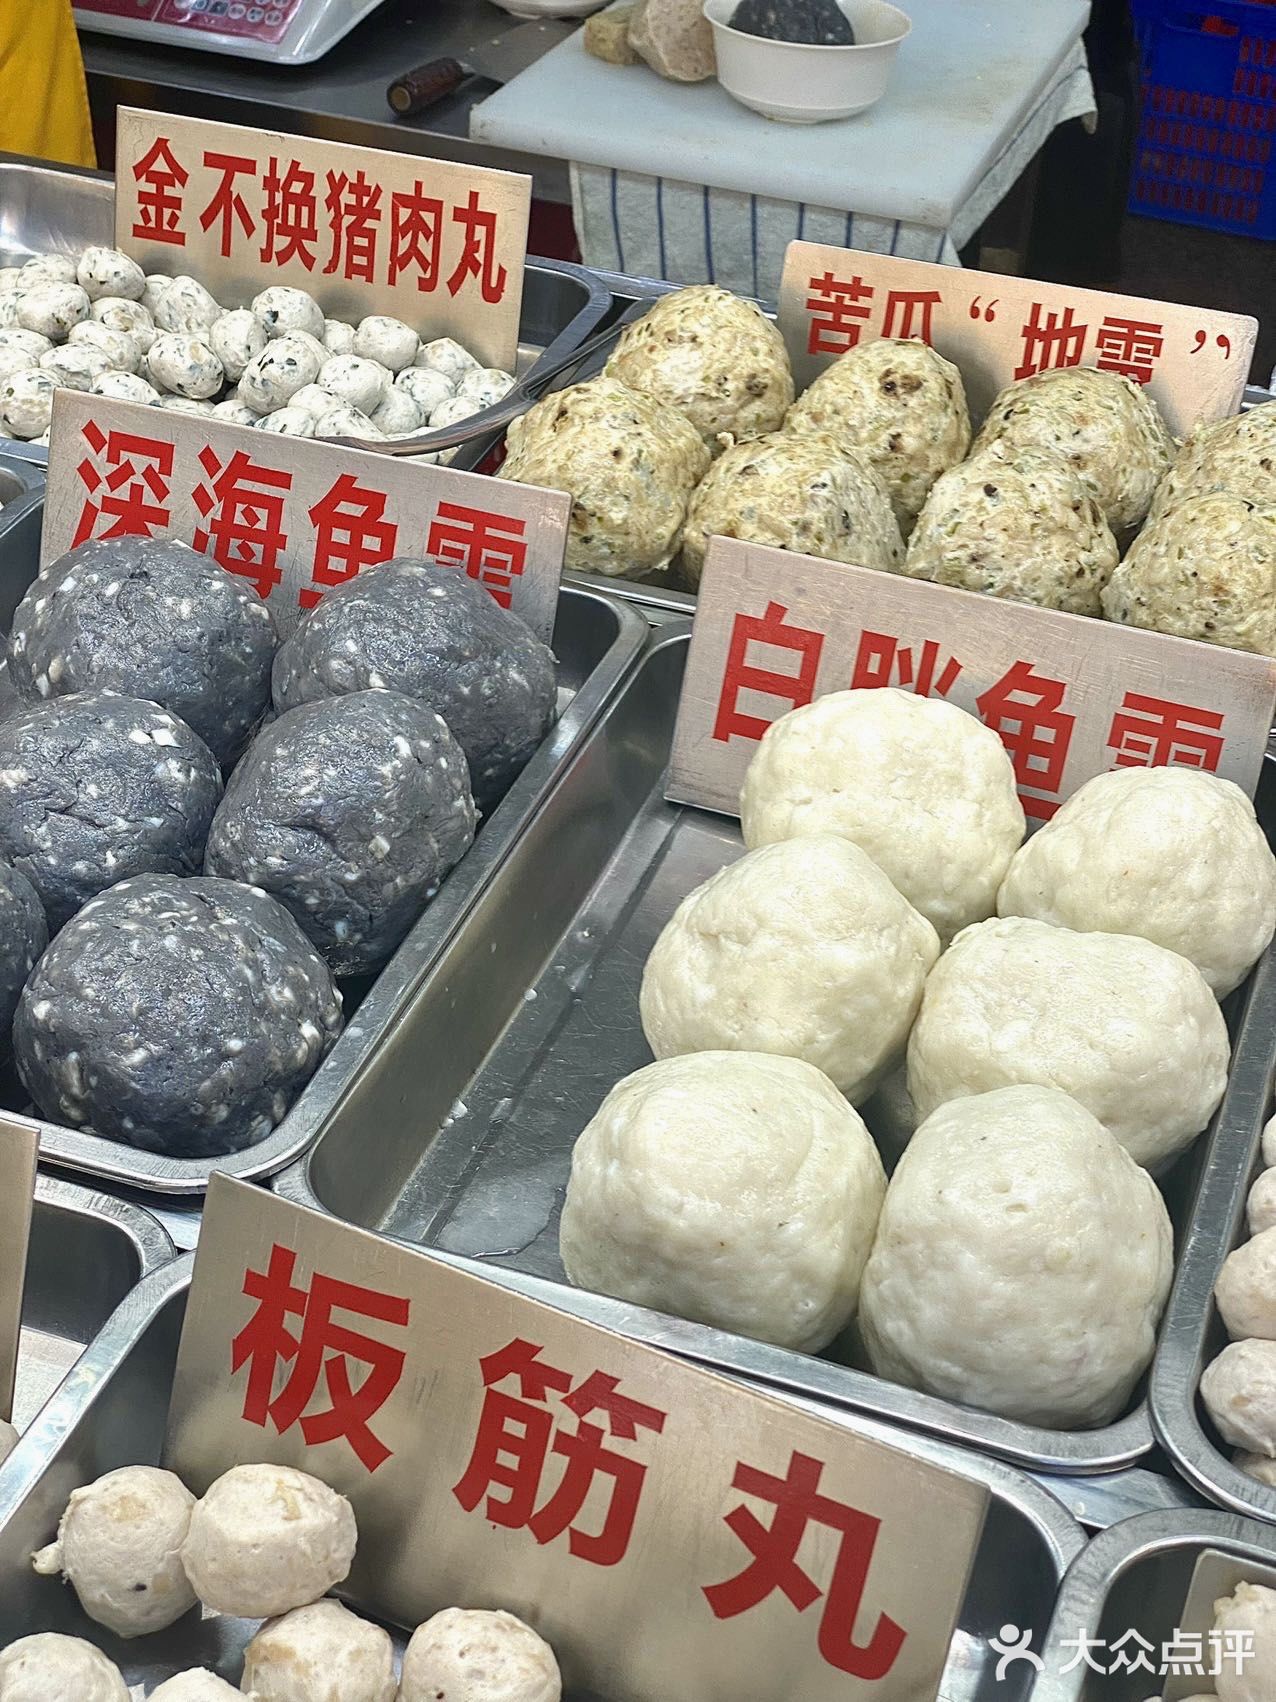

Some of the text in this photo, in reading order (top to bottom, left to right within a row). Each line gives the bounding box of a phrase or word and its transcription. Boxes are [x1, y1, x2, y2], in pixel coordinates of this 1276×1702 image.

[132, 136, 508, 304] 金不换猪肉丸
[231, 1242, 908, 1681] 板筋丸
